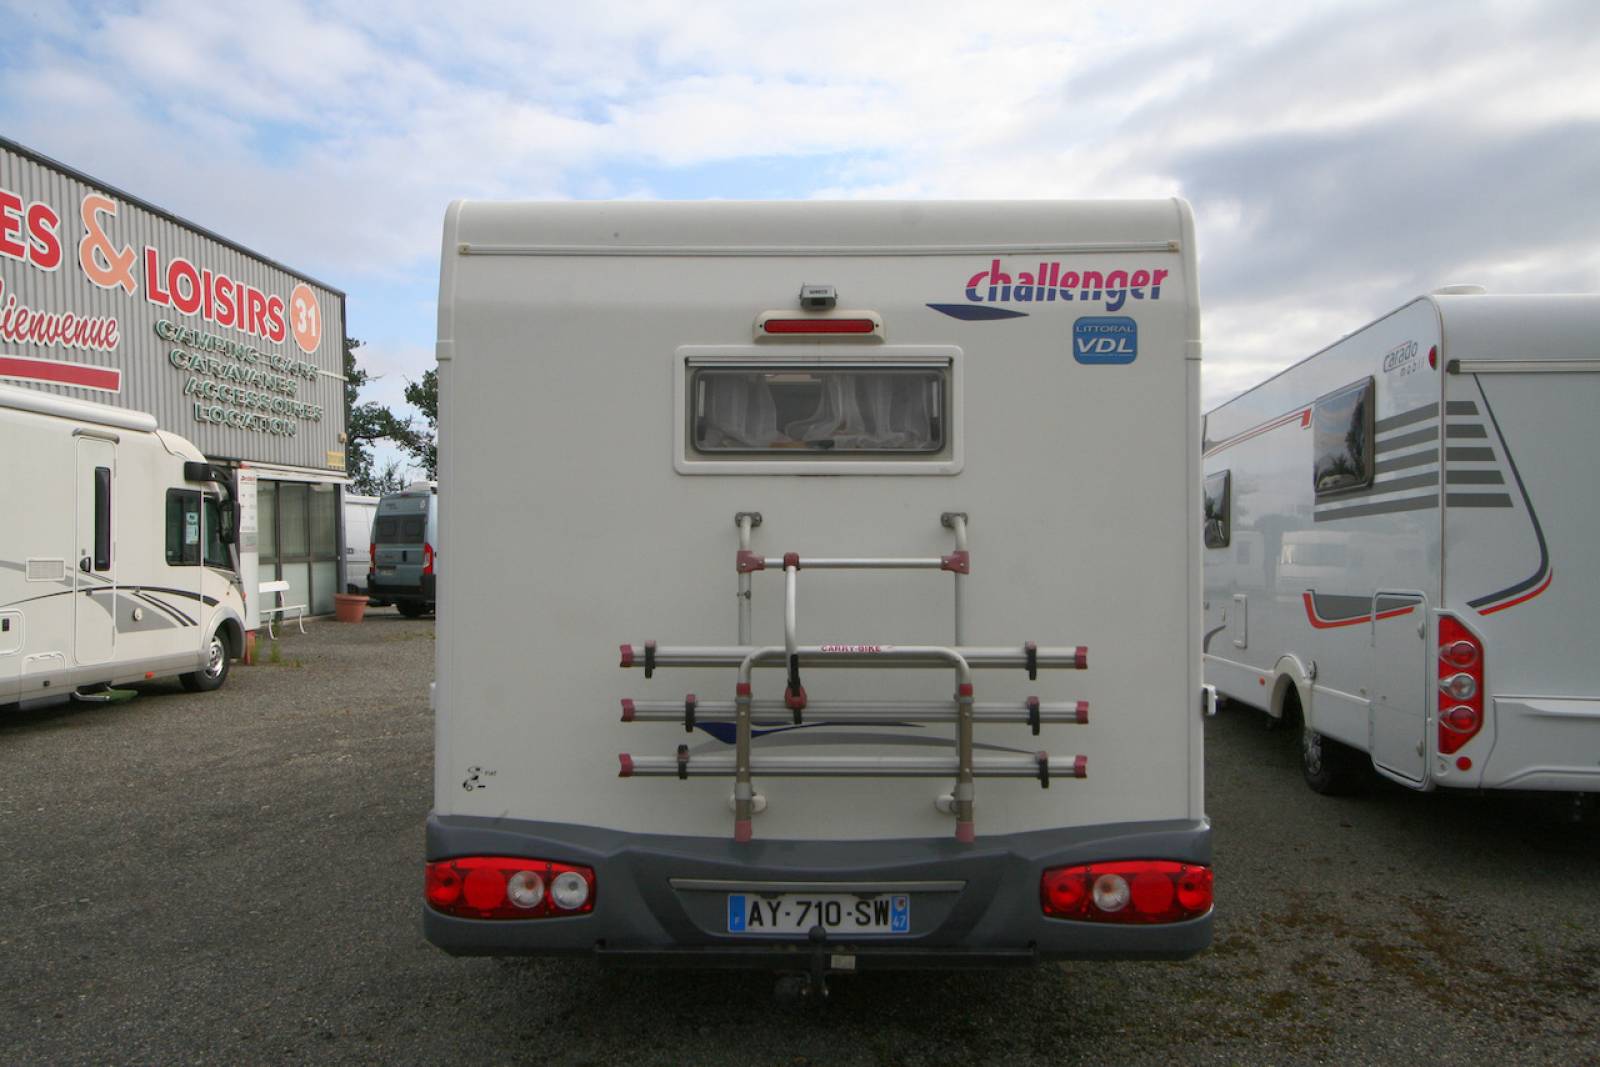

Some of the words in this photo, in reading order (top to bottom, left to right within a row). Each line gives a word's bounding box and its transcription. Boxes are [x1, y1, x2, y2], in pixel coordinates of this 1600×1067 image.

[79, 194, 138, 296] &
[145, 246, 286, 344] LOISIRS
[296, 298, 317, 337] 31
[965, 259, 1168, 312] challenger
[1076, 325, 1134, 333] LITTORAL
[1077, 337, 1134, 353] VDL
[169, 348, 298, 398] CARAVANES
[1383, 341, 1418, 373] carado
[184, 376, 324, 422] ACCESSOIRES
[193, 402, 298, 438] LOCATION
